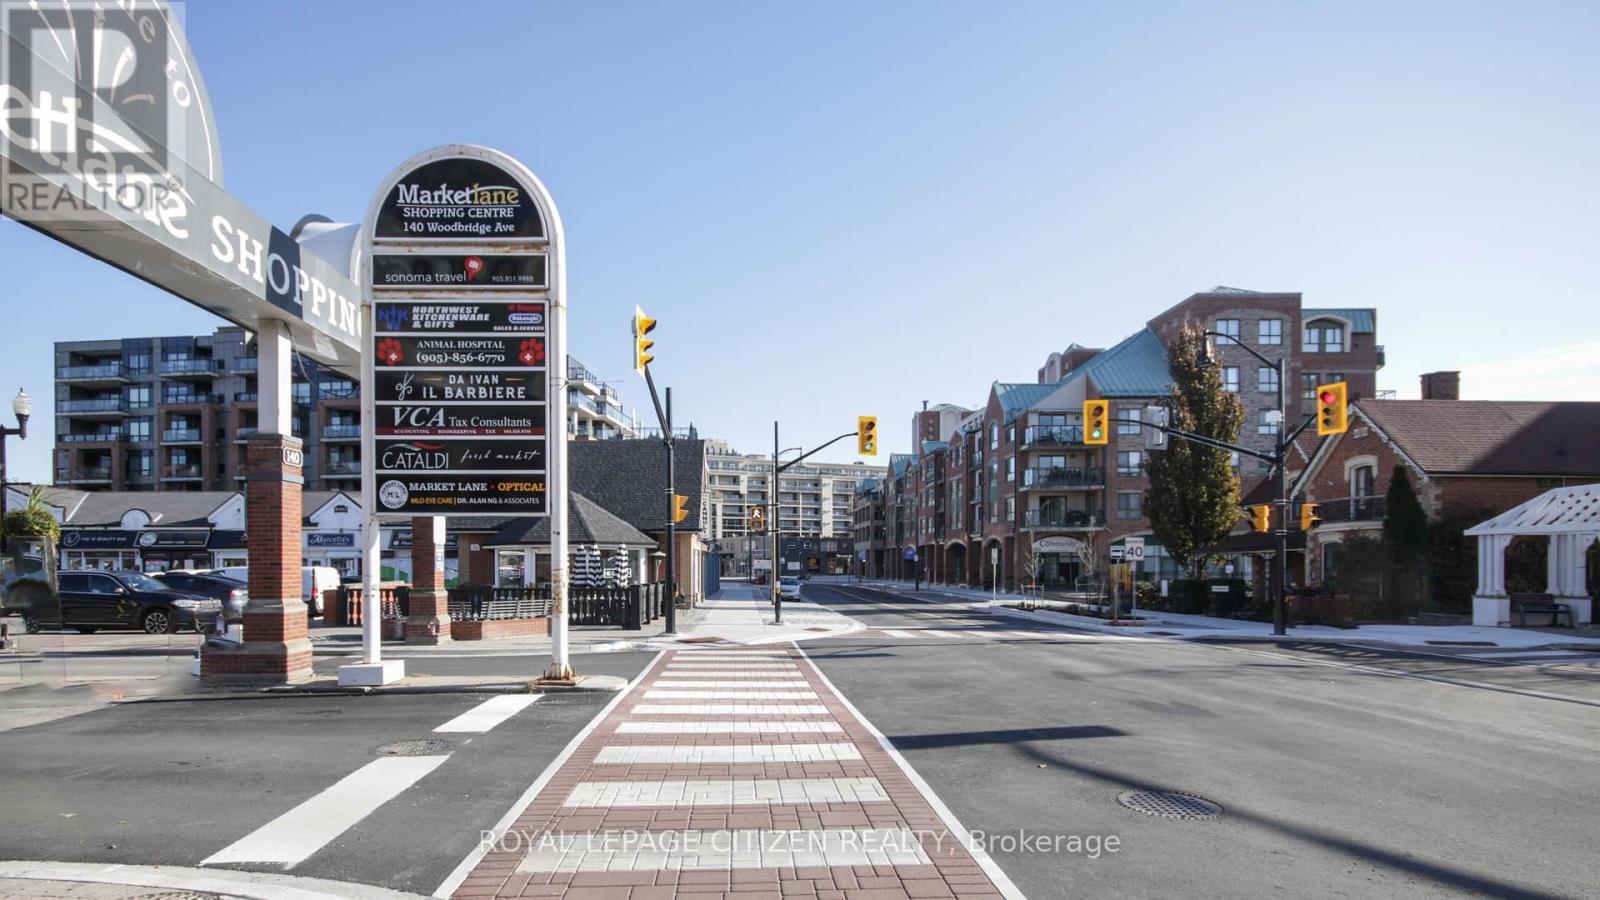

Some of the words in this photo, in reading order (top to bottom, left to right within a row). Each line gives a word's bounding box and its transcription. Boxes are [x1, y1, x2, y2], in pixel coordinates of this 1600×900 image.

[164, 56, 191, 107] to
[397, 183, 519, 205] Marketlane
[403, 207, 464, 218] SHOPPING
[468, 207, 514, 218] CENTRE
[403, 222, 424, 232] 140
[427, 221, 492, 235] Woodbridge
[494, 222, 515, 232] Ave
[211, 215, 361, 337] SHOPPIN
[385, 272, 432, 282] sonoma
[435, 270, 467, 282] travel
[412, 306, 480, 314] NORTHWEST
[412, 313, 491, 321] KITCHENWARE
[412, 321, 422, 329] &
[424, 321, 456, 329] GIFTS
[417, 340, 456, 349] ANIMAL
[458, 340, 505, 349] HOSPITAL
[416, 353, 506, 364] (905)-856-6770
[448, 375, 464, 384] DA
[470, 375, 499, 384] IVAN
[422, 387, 438, 398] IL
[445, 387, 526, 398] BARBIERE
[393, 407, 446, 427] VCA
[449, 417, 467, 427] Tax
[471, 416, 532, 427] Consultants
[286, 450, 300, 465] 140
[382, 451, 449, 469] CATALDI
[460, 449, 491, 463] fresh
[496, 450, 541, 461] market
[409, 483, 455, 491] MARKET
[458, 483, 488, 491] LANE
[497, 482, 545, 491] OPTICAL
[1127, 546, 1143, 557] 40
